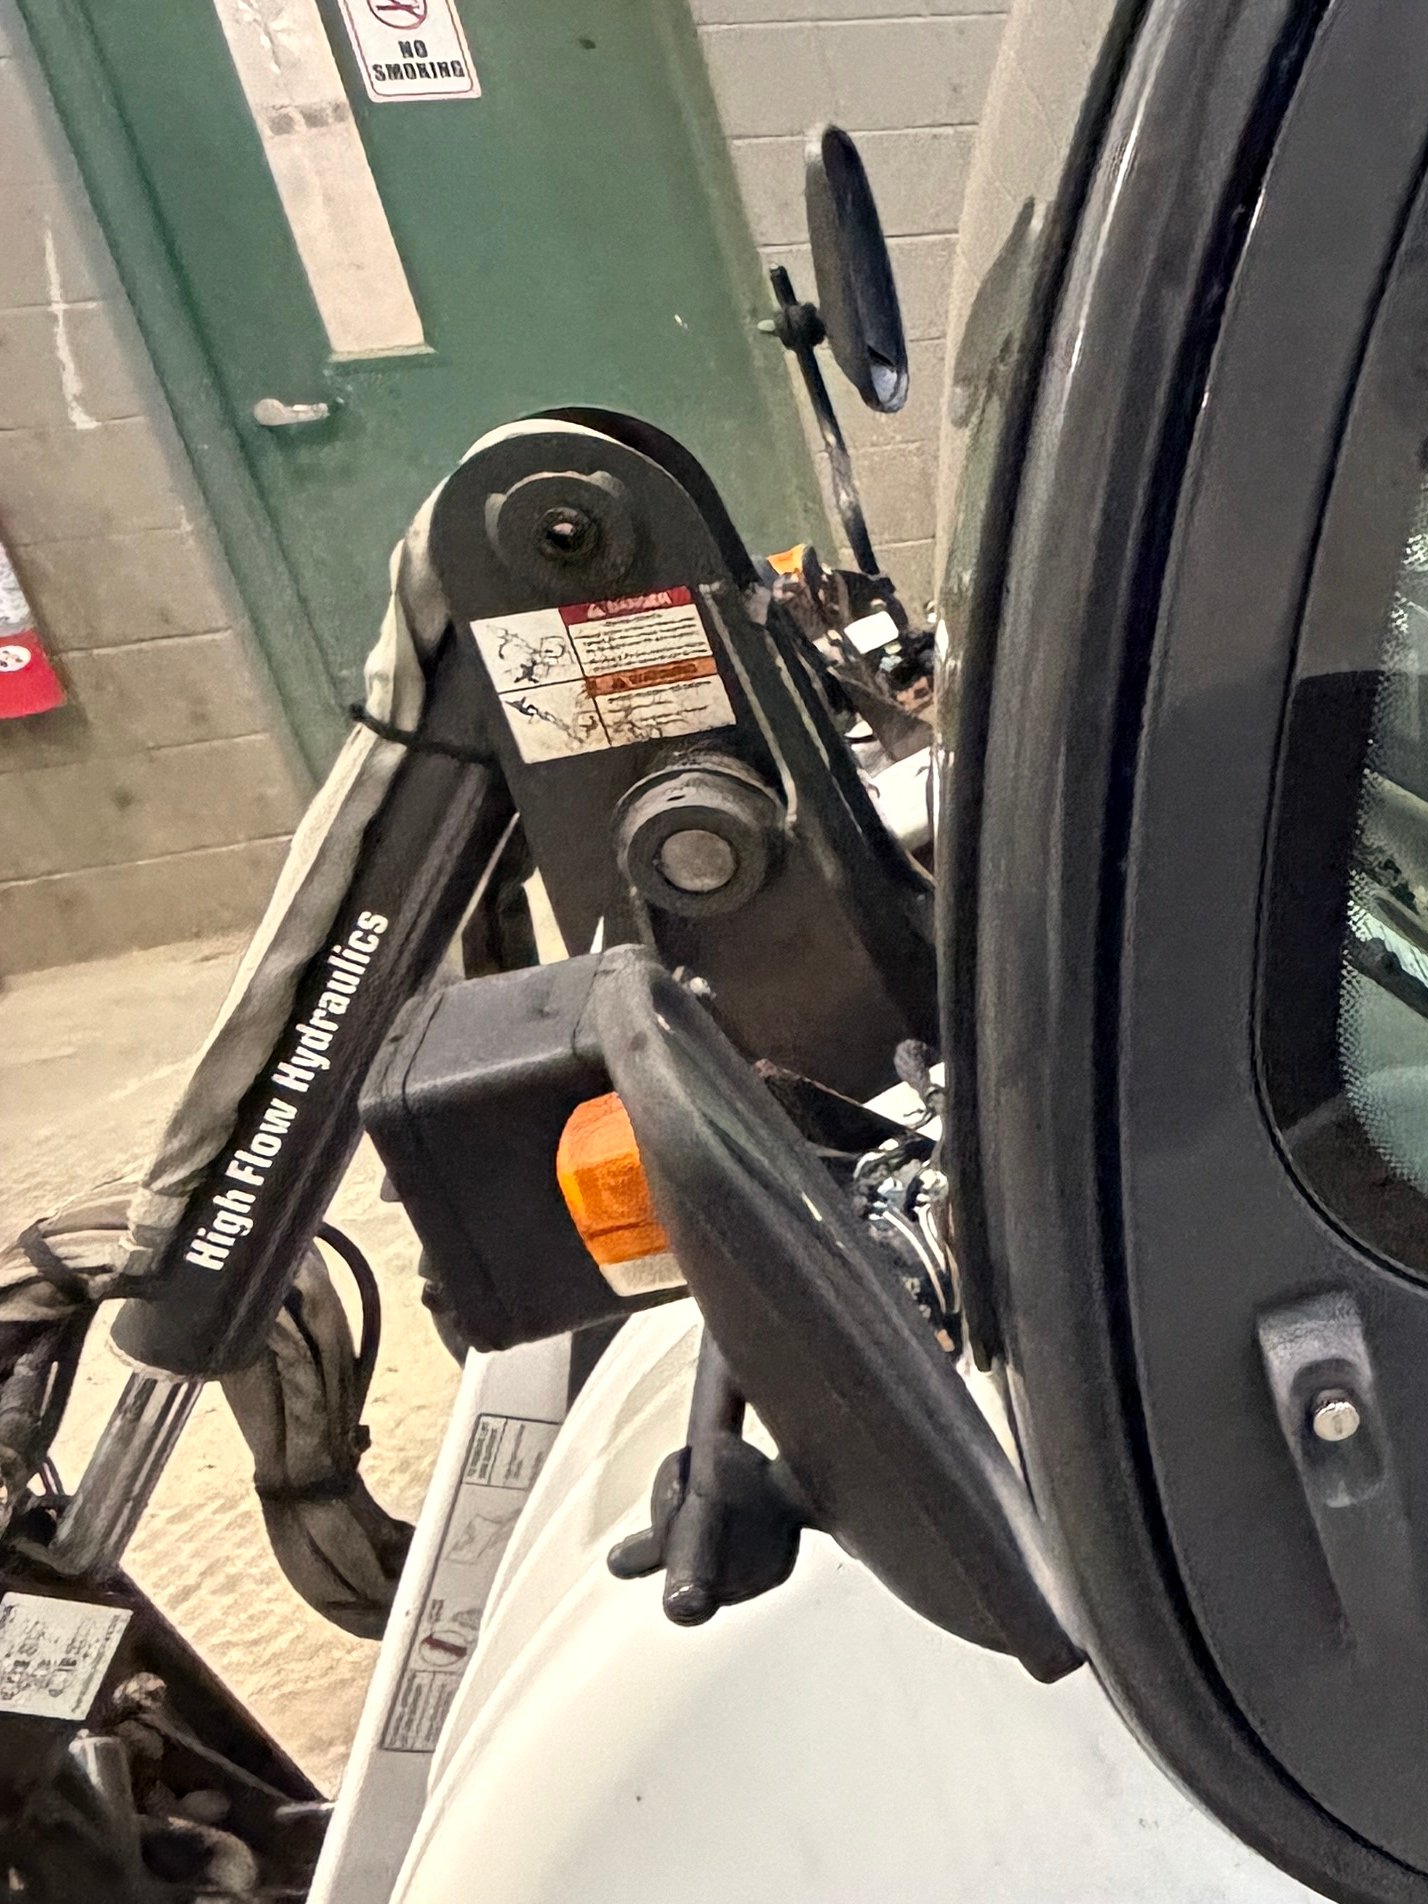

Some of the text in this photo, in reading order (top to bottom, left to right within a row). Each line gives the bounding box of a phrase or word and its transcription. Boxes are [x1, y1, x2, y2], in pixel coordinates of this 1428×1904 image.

[398, 39, 428, 59] NO
[372, 59, 466, 82] SMOKING
[185, 909, 390, 1272] High Flow Hydraulics
